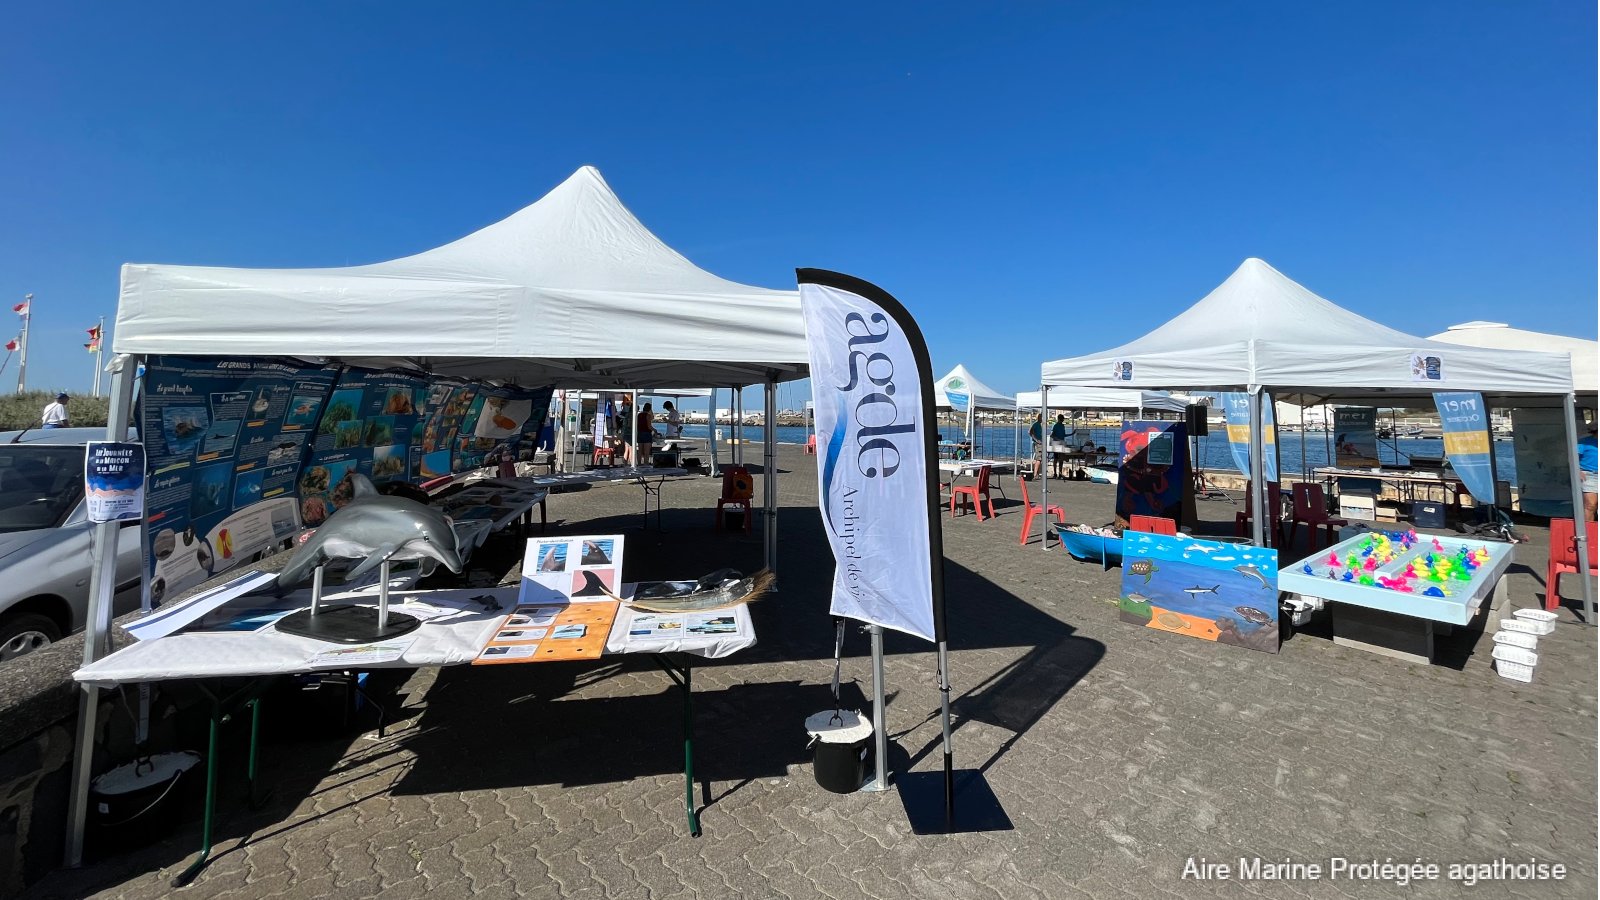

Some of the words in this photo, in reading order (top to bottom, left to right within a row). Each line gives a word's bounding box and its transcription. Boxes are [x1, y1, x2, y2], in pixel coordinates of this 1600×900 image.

[836, 312, 915, 478] agde
[1339, 412, 1367, 420] mer
[839, 484, 862, 559] Archipel
[847, 563, 862, 581] de
